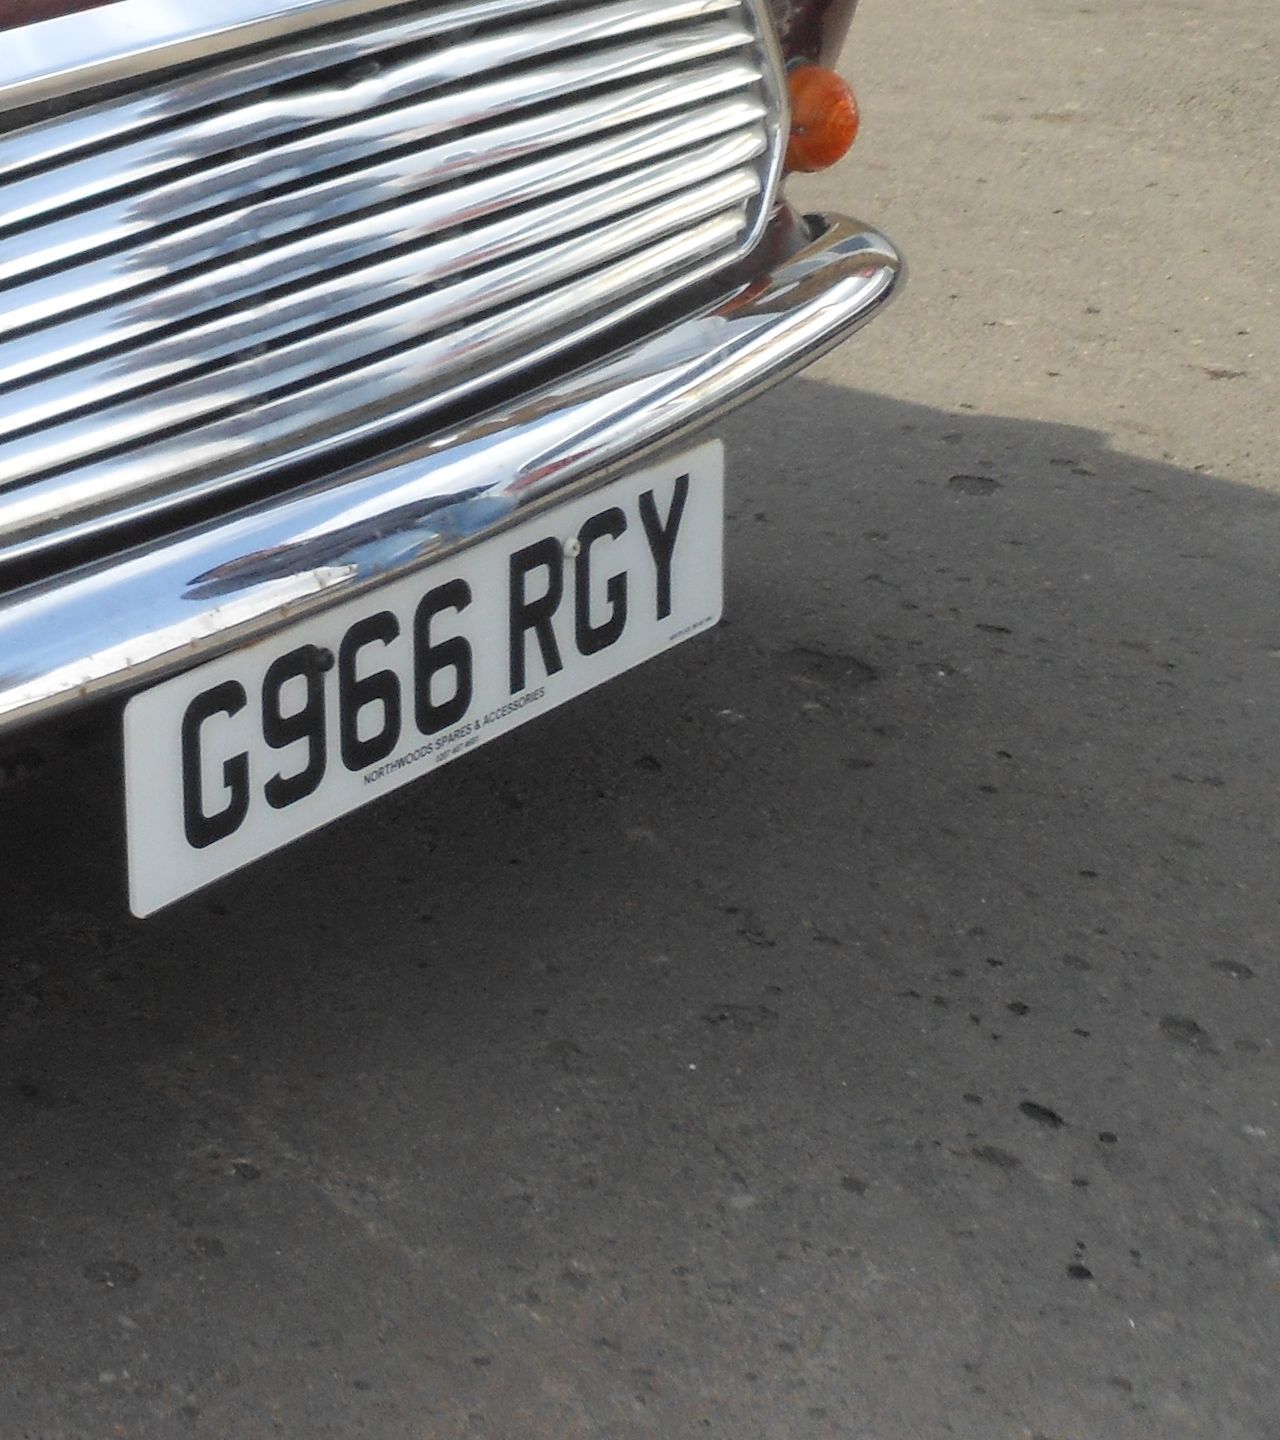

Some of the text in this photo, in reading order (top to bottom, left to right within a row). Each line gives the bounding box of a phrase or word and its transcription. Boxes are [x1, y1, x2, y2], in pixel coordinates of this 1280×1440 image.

[180, 473, 690, 850] G966 RGY
[434, 723, 472, 751] SPARES
[482, 686, 546, 727] ACCESSORIES
